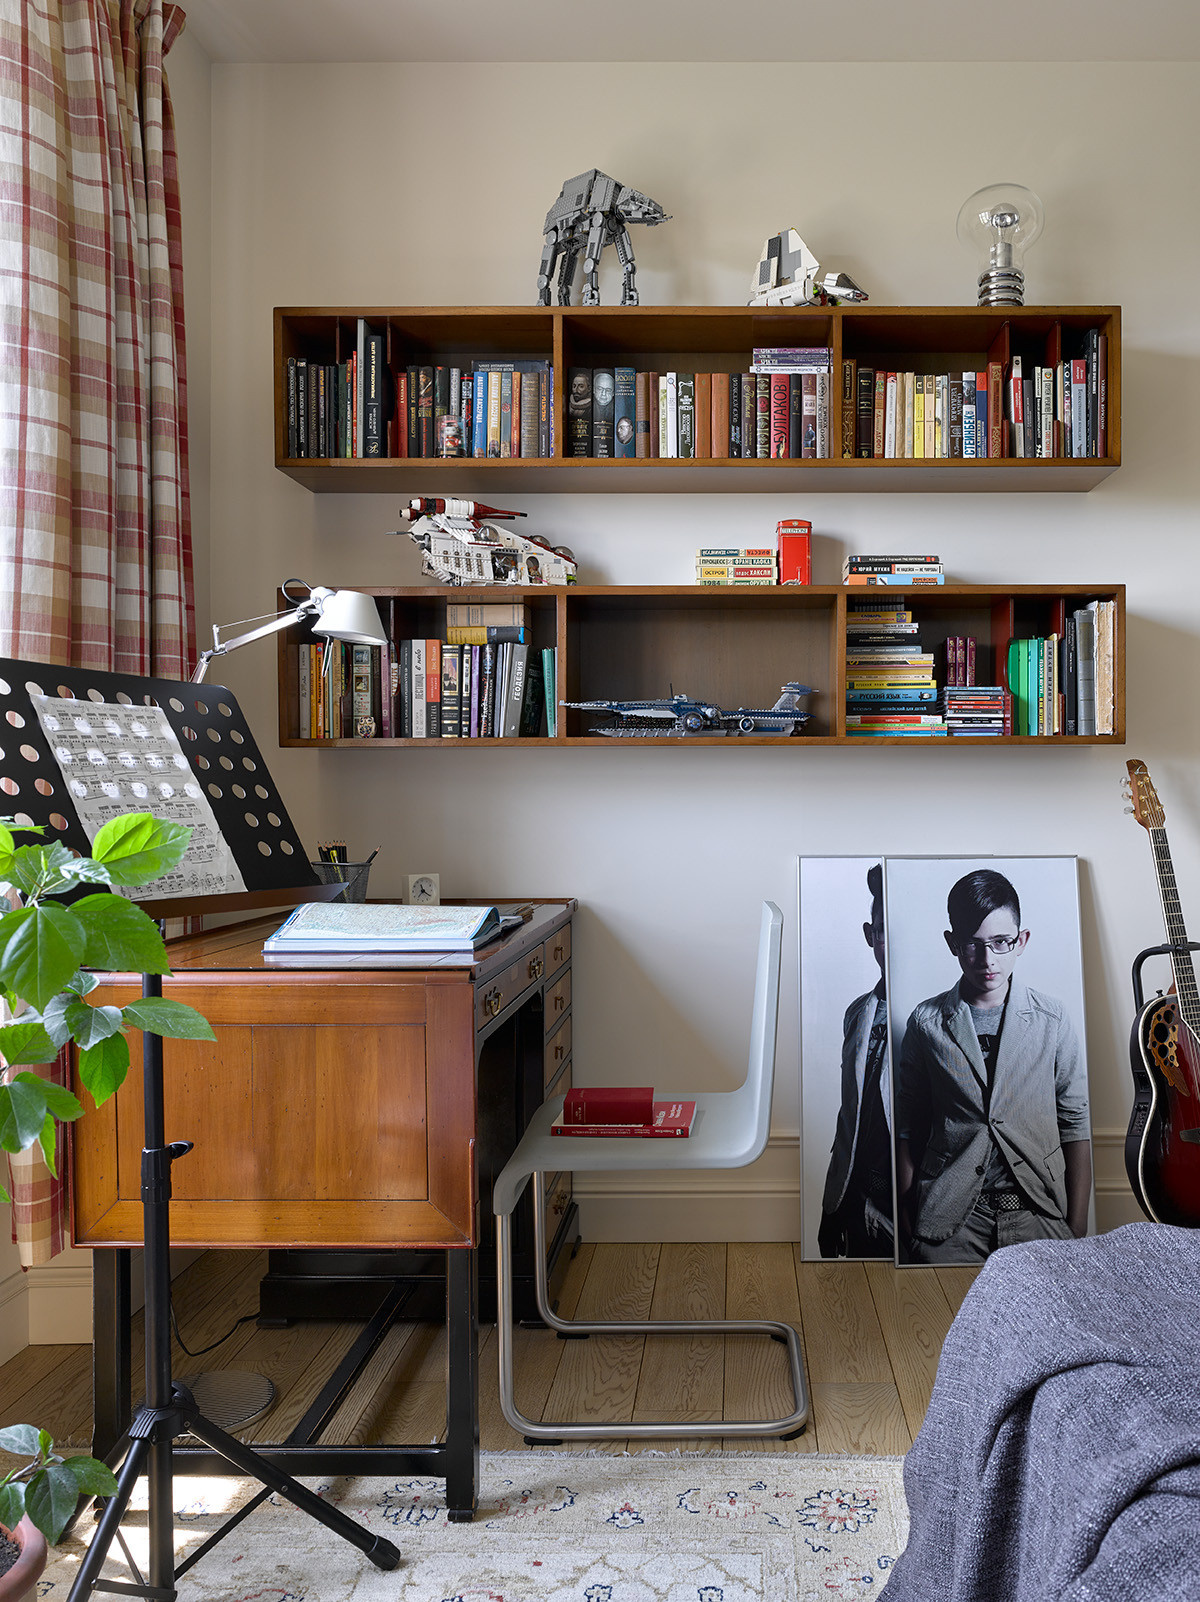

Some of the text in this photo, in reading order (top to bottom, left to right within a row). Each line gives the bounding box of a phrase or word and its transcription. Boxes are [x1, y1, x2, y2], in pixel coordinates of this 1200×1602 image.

[773, 384, 787, 443] БУЛГАКОВ
[414, 673, 425, 700] ЛЕСТНИЦА
[514, 660, 524, 701] ГЕОДЕЗИЯ
[859, 692, 886, 700] РУССКИЙ
